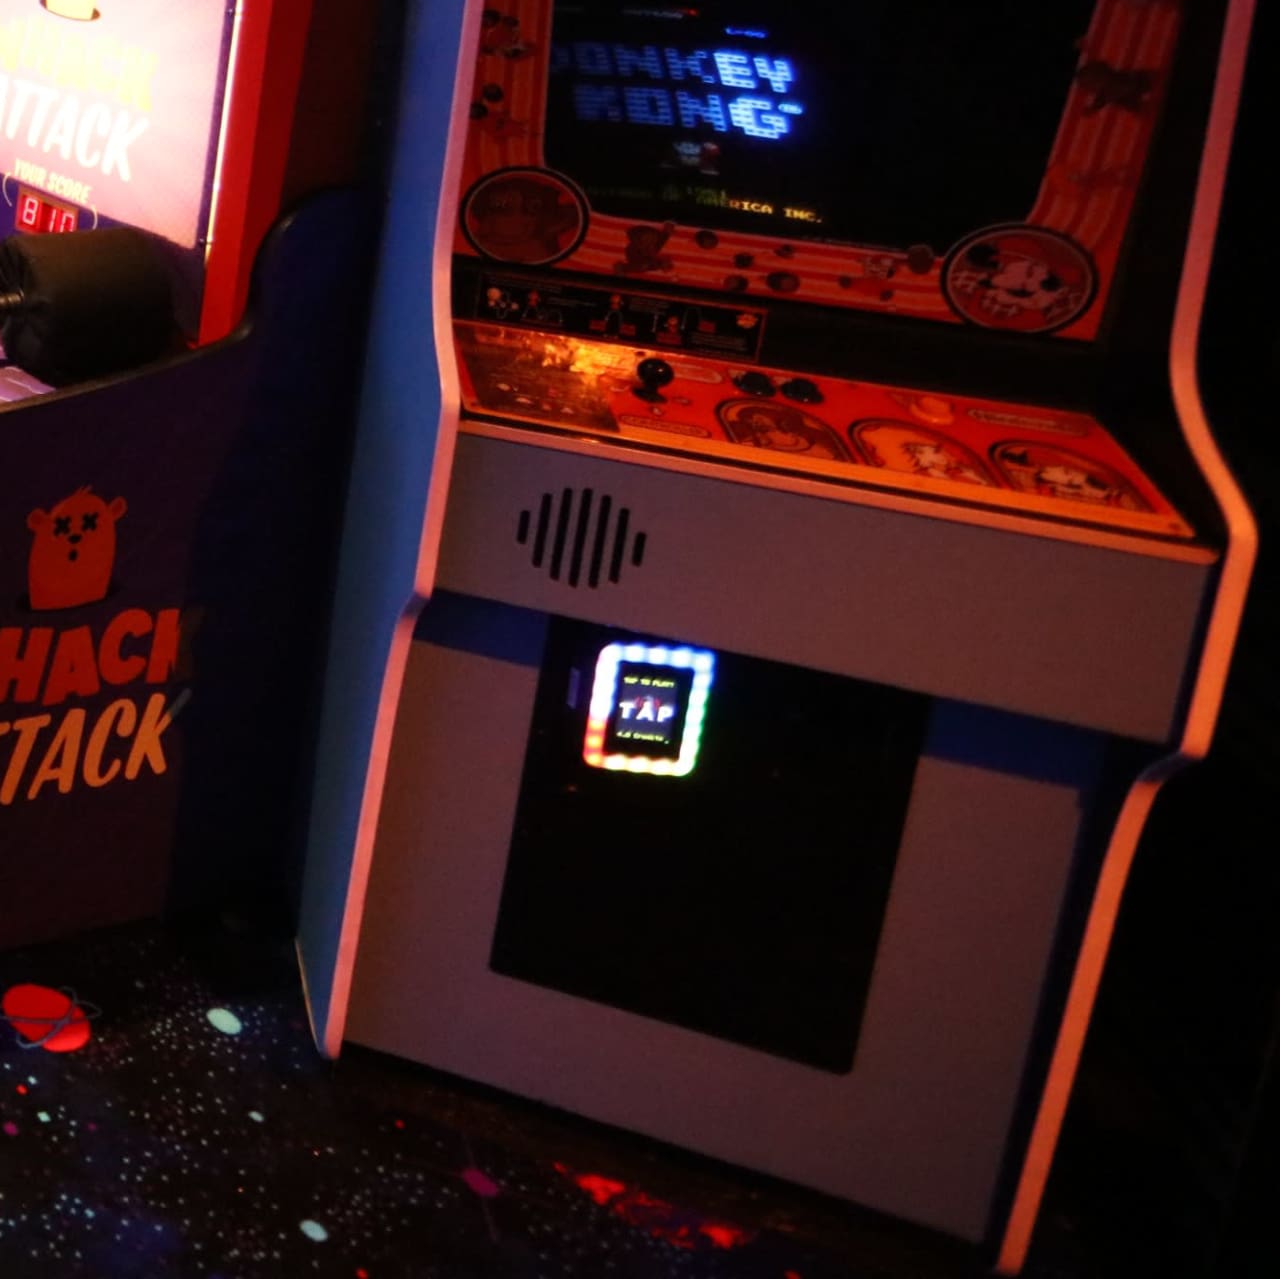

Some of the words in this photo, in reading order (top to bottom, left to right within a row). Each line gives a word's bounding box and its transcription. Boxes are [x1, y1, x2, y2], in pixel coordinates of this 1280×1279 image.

[14, 158, 49, 187] YOUR
[46, 172, 93, 204] SCORE
[618, 699, 675, 723] TAP
